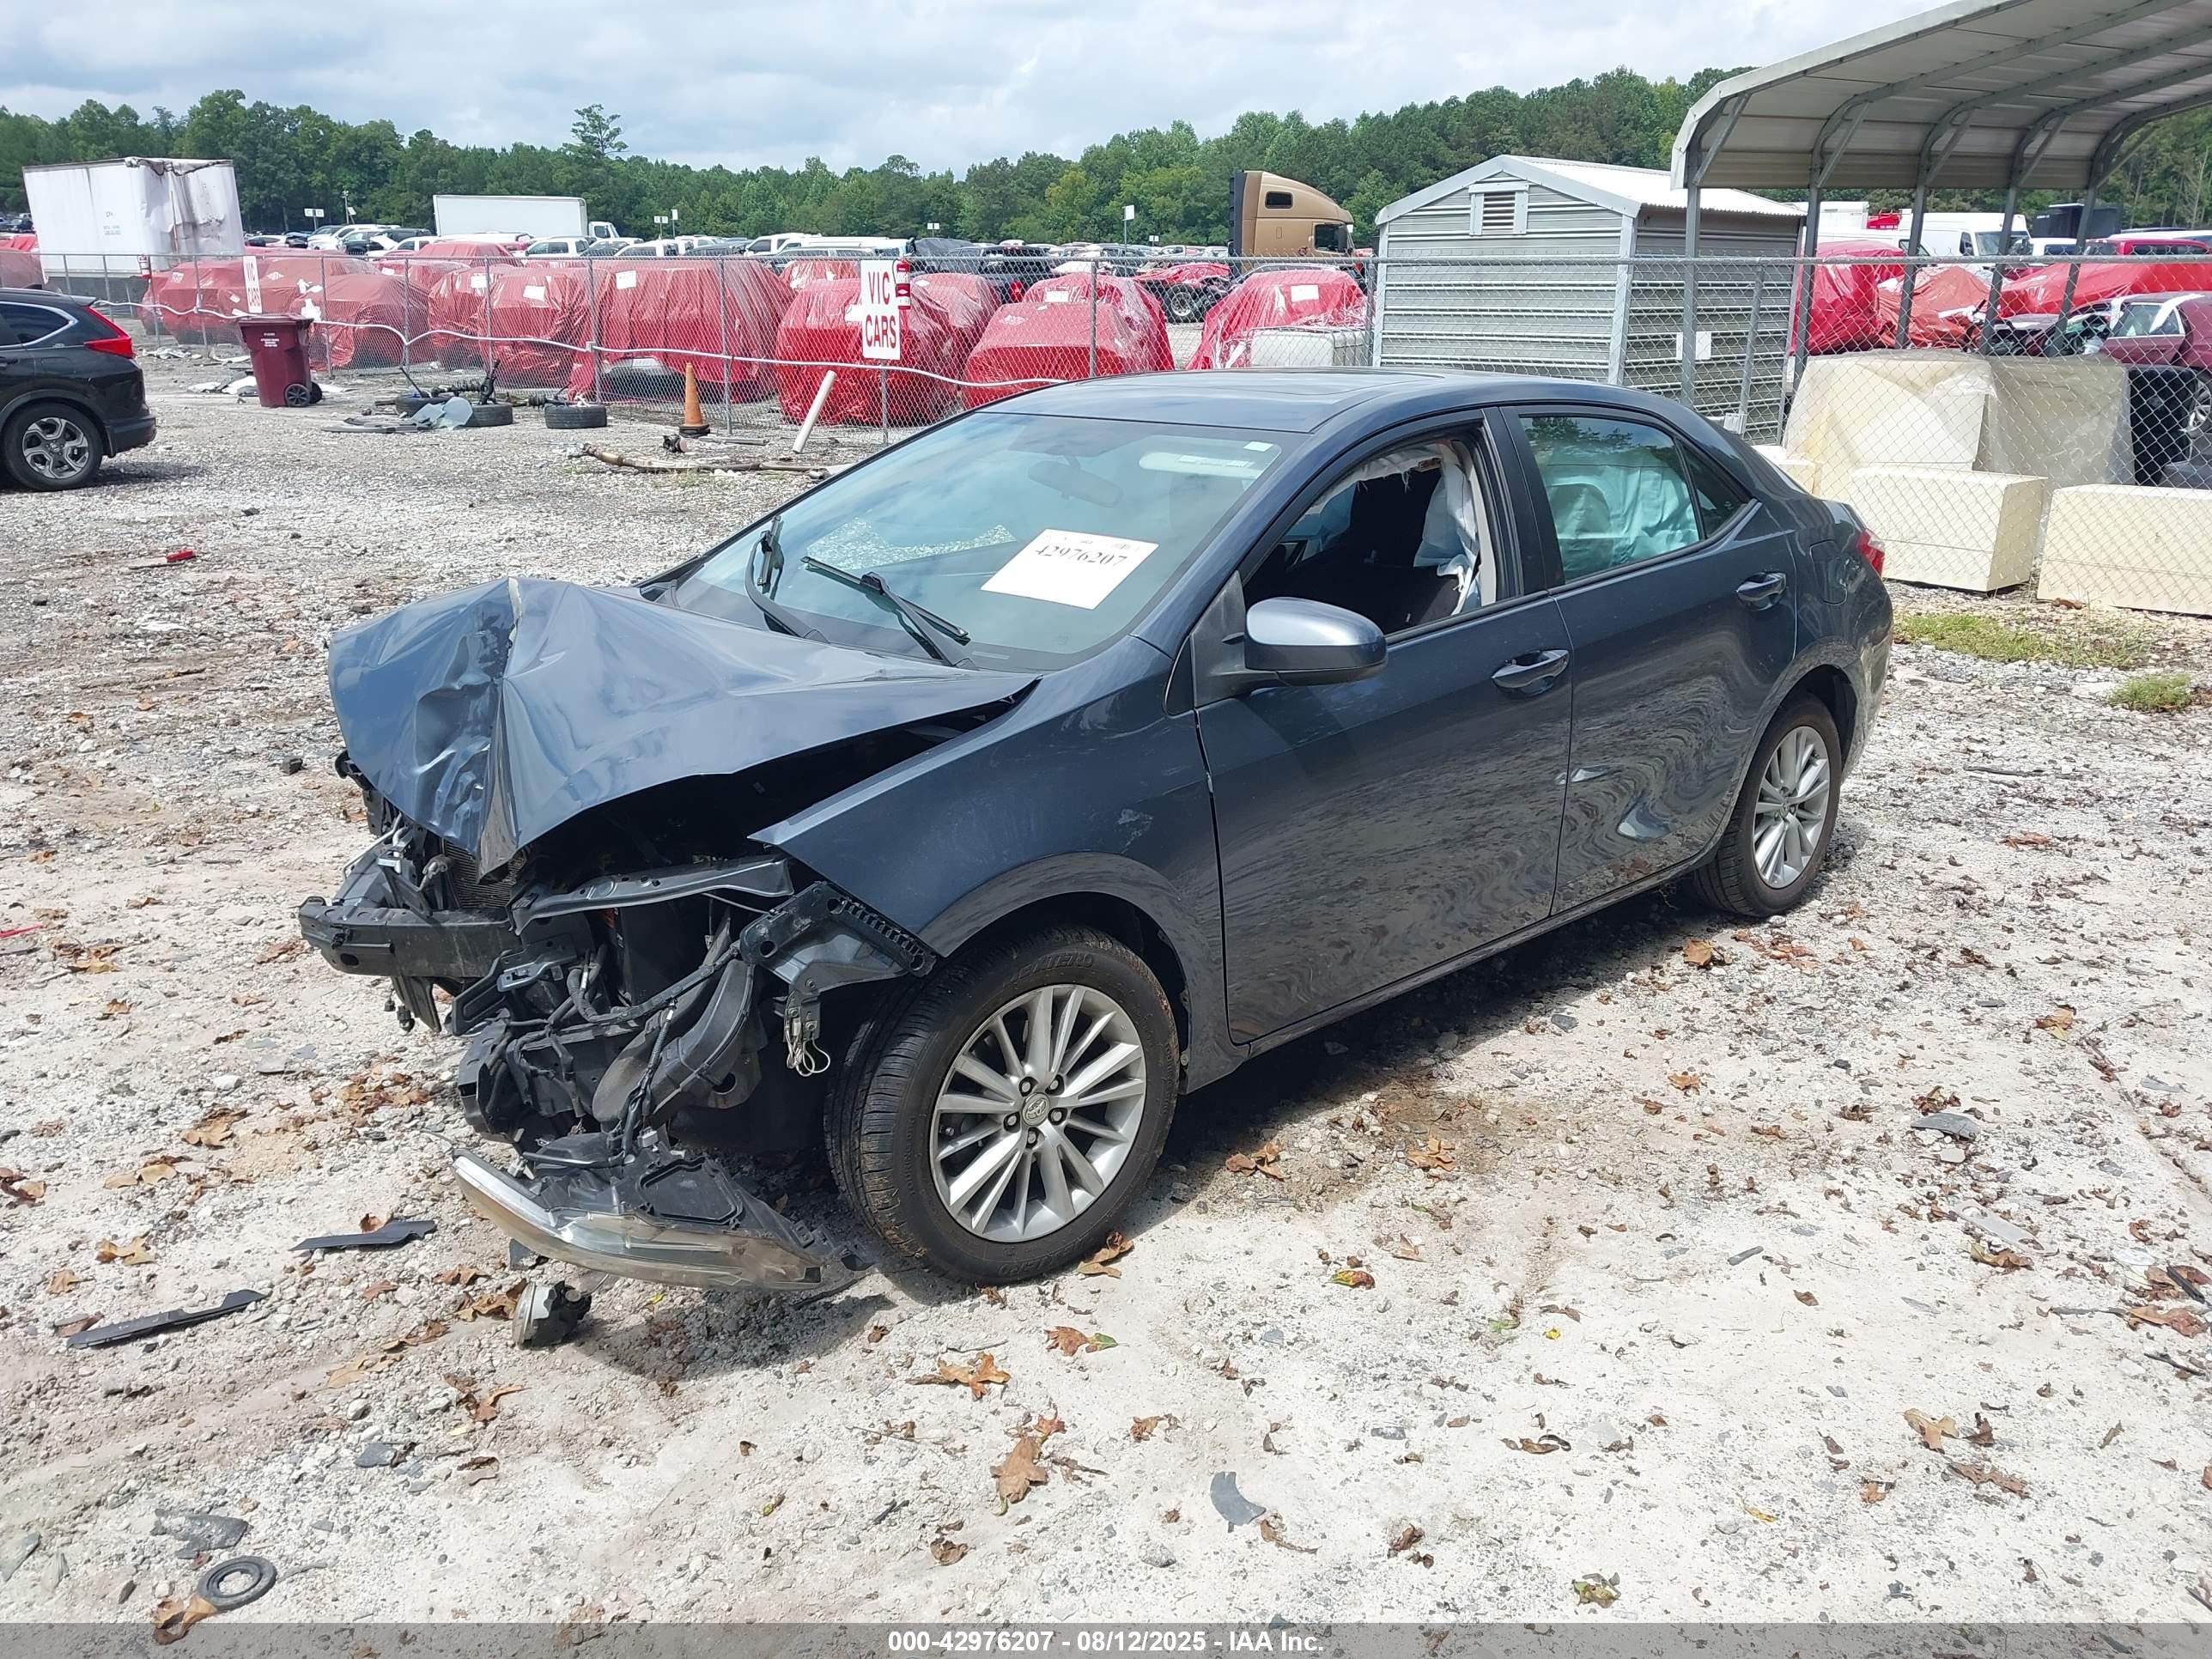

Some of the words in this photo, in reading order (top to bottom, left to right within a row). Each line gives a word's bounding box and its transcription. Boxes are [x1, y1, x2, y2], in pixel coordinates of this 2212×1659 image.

[868, 271, 890, 304] VIC
[866, 314, 896, 349] CARS
[1036, 544, 1127, 567] 42976207
